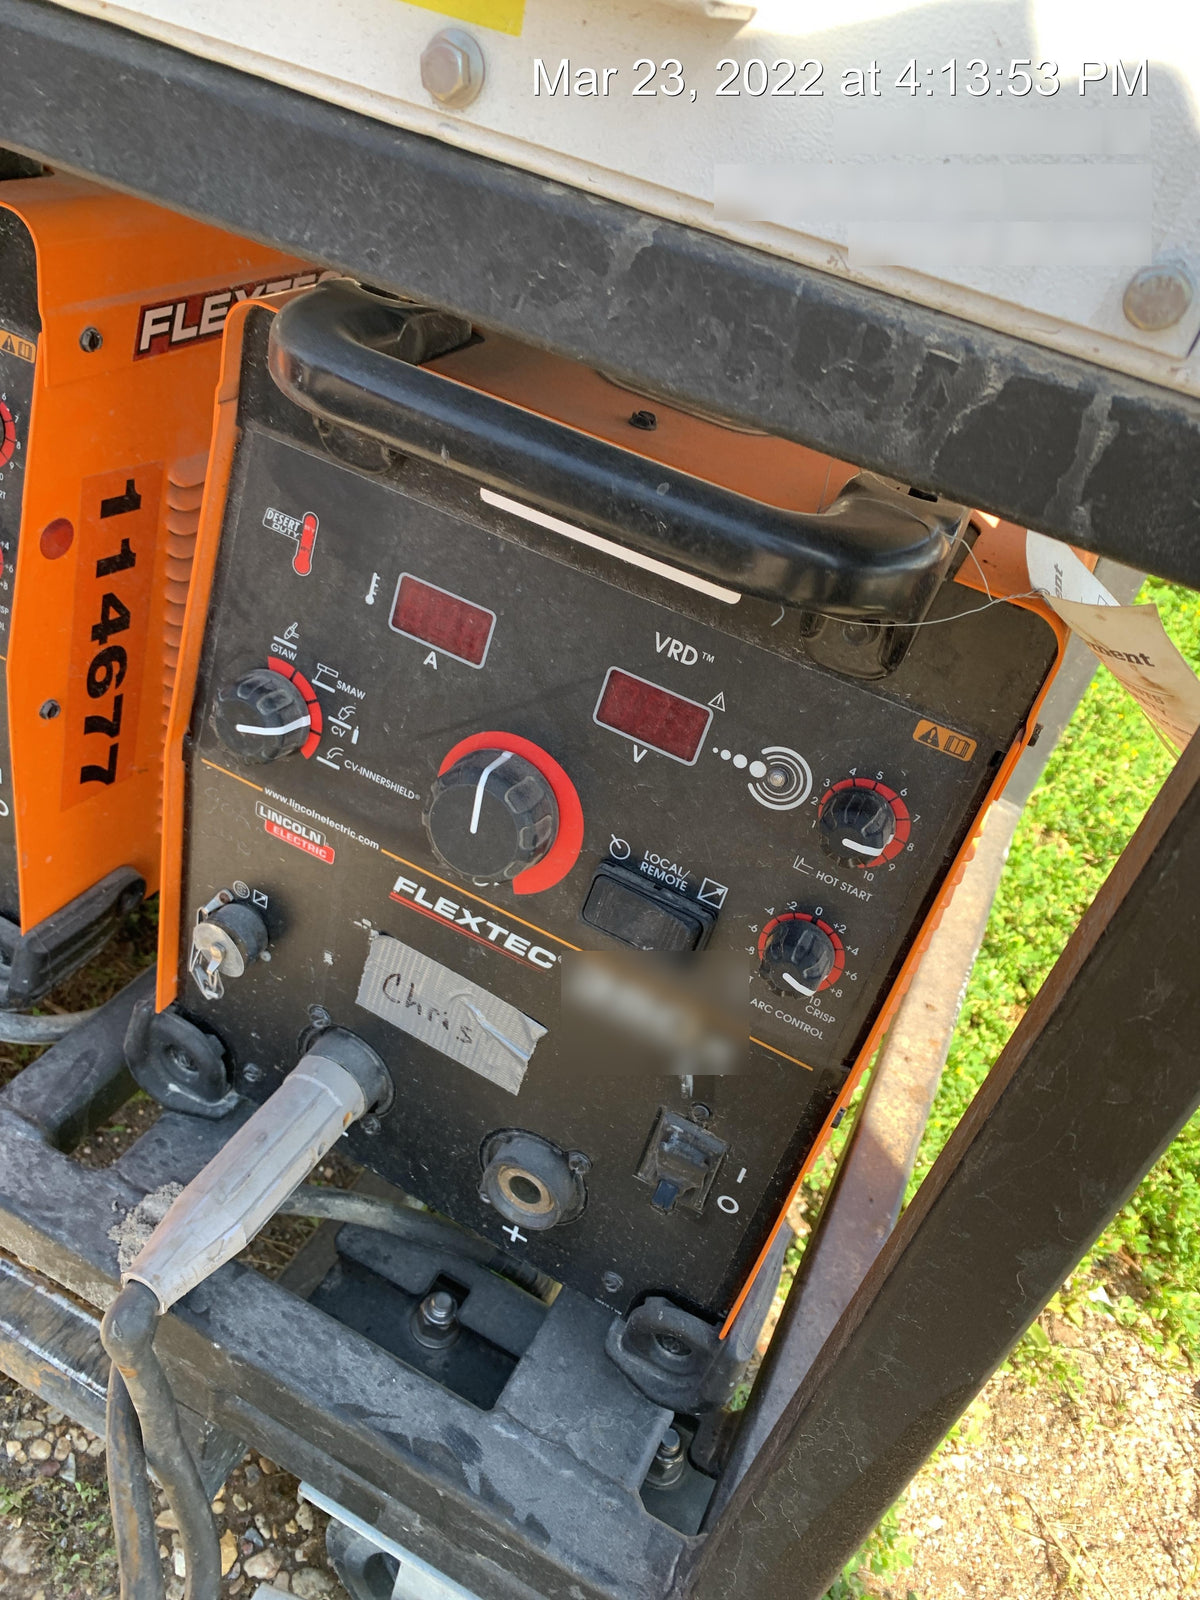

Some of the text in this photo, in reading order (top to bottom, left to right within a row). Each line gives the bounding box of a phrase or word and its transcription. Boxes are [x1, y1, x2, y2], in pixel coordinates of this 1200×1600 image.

[266, 509, 301, 532] DESERT
[271, 523, 300, 539] DUTY
[80, 478, 142, 786] 114677
[270, 642, 298, 661] GTAW
[655, 631, 699, 666] VRD
[423, 651, 438, 670] A
[336, 680, 367, 700] SMAW
[331, 726, 346, 738] CV
[633, 744, 648, 763] V
[849, 767, 857, 776] 4
[876, 771, 884, 780] 5
[823, 778, 831, 788] 3
[900, 787, 908, 797] 6
[811, 796, 819, 806] 2
[264, 787, 380, 850] www.lincolnelectric.com
[913, 813, 921, 823] 7
[260, 805, 322, 846] LINCOLN
[811, 820, 817, 829] 1
[272, 825, 328, 859] ELECTRIC
[906, 842, 915, 852] 8
[643, 850, 691, 880] LOCAL/
[888, 863, 896, 872] 9
[640, 861, 688, 892] REMOTE
[863, 870, 875, 882] 10
[815, 870, 874, 902] HOT START
[764, 906, 776, 916] -4
[786, 901, 798, 911] -2
[815, 906, 824, 916] 0
[748, 924, 759, 934] -6
[833, 922, 847, 934] +2
[845, 945, 860, 956] +4
[845, 970, 858, 981] +6
[830, 987, 843, 998] +8
[382, 973, 474, 1045] Chris
[805, 1005, 836, 1025] CRISP
[750, 998, 824, 1040] ARC CONTROL
